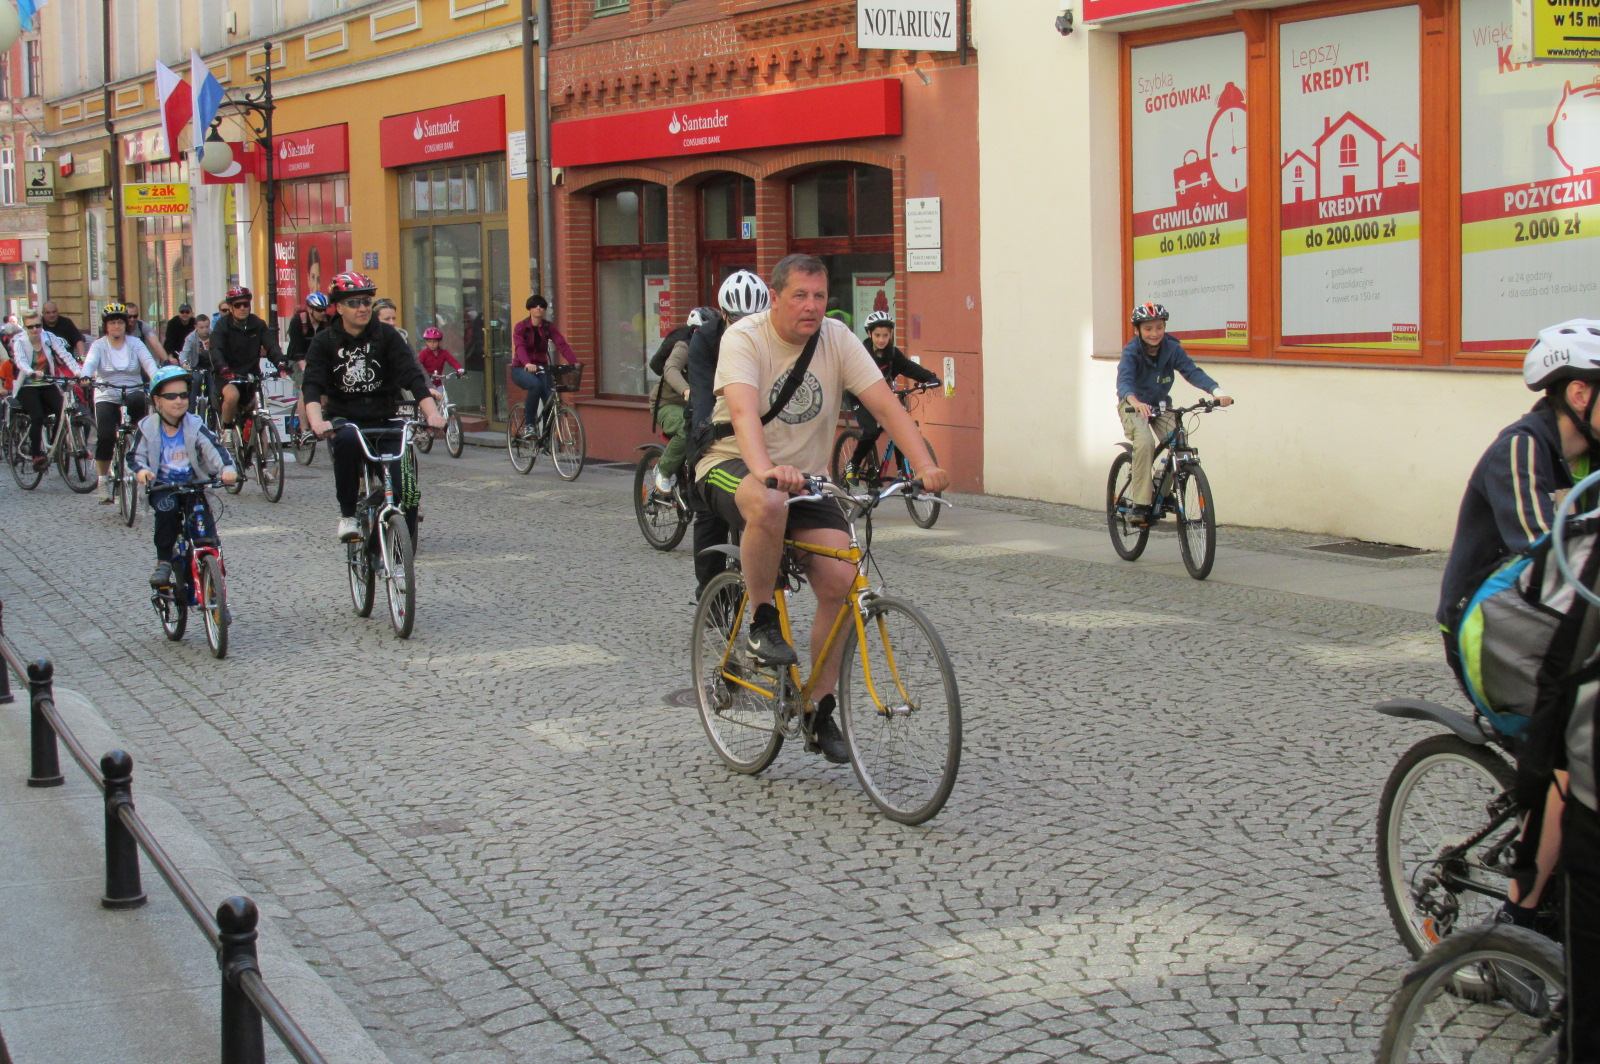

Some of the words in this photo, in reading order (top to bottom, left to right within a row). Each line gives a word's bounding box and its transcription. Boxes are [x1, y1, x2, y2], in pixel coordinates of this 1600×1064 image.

[864, 8, 952, 38] NOTARIUSZ
[1554, 15, 1565, 26] w
[1569, 12, 1584, 27] 15
[1292, 40, 1340, 70] Lepszy
[1137, 72, 1173, 94] Szybka
[1302, 62, 1370, 94] KREDYT!
[1145, 84, 1211, 113] GOTÓWKA!
[423, 114, 460, 138] Santander
[682, 109, 728, 132] Santander
[287, 138, 315, 158] Santander
[683, 137, 708, 147] CONSUMER
[708, 135, 721, 145] BANK
[152, 185, 175, 197] żak
[1503, 179, 1593, 212] POŻYCZKI
[144, 203, 188, 214] DARMO!
[1152, 202, 1229, 231] CHWILÓWKI
[1319, 193, 1383, 219] KREDYTY
[1160, 236, 1174, 253] do
[1177, 231, 1207, 251] 1.000
[1209, 227, 1220, 246] zł
[1306, 229, 1323, 248] do
[1326, 221, 1379, 246] 200.000
[1383, 218, 1397, 238] zł
[1515, 217, 1560, 242] 2.000
[1564, 213, 1581, 236] zł
[275, 241, 295, 264] Wejdź
[1543, 349, 1570, 368] city
